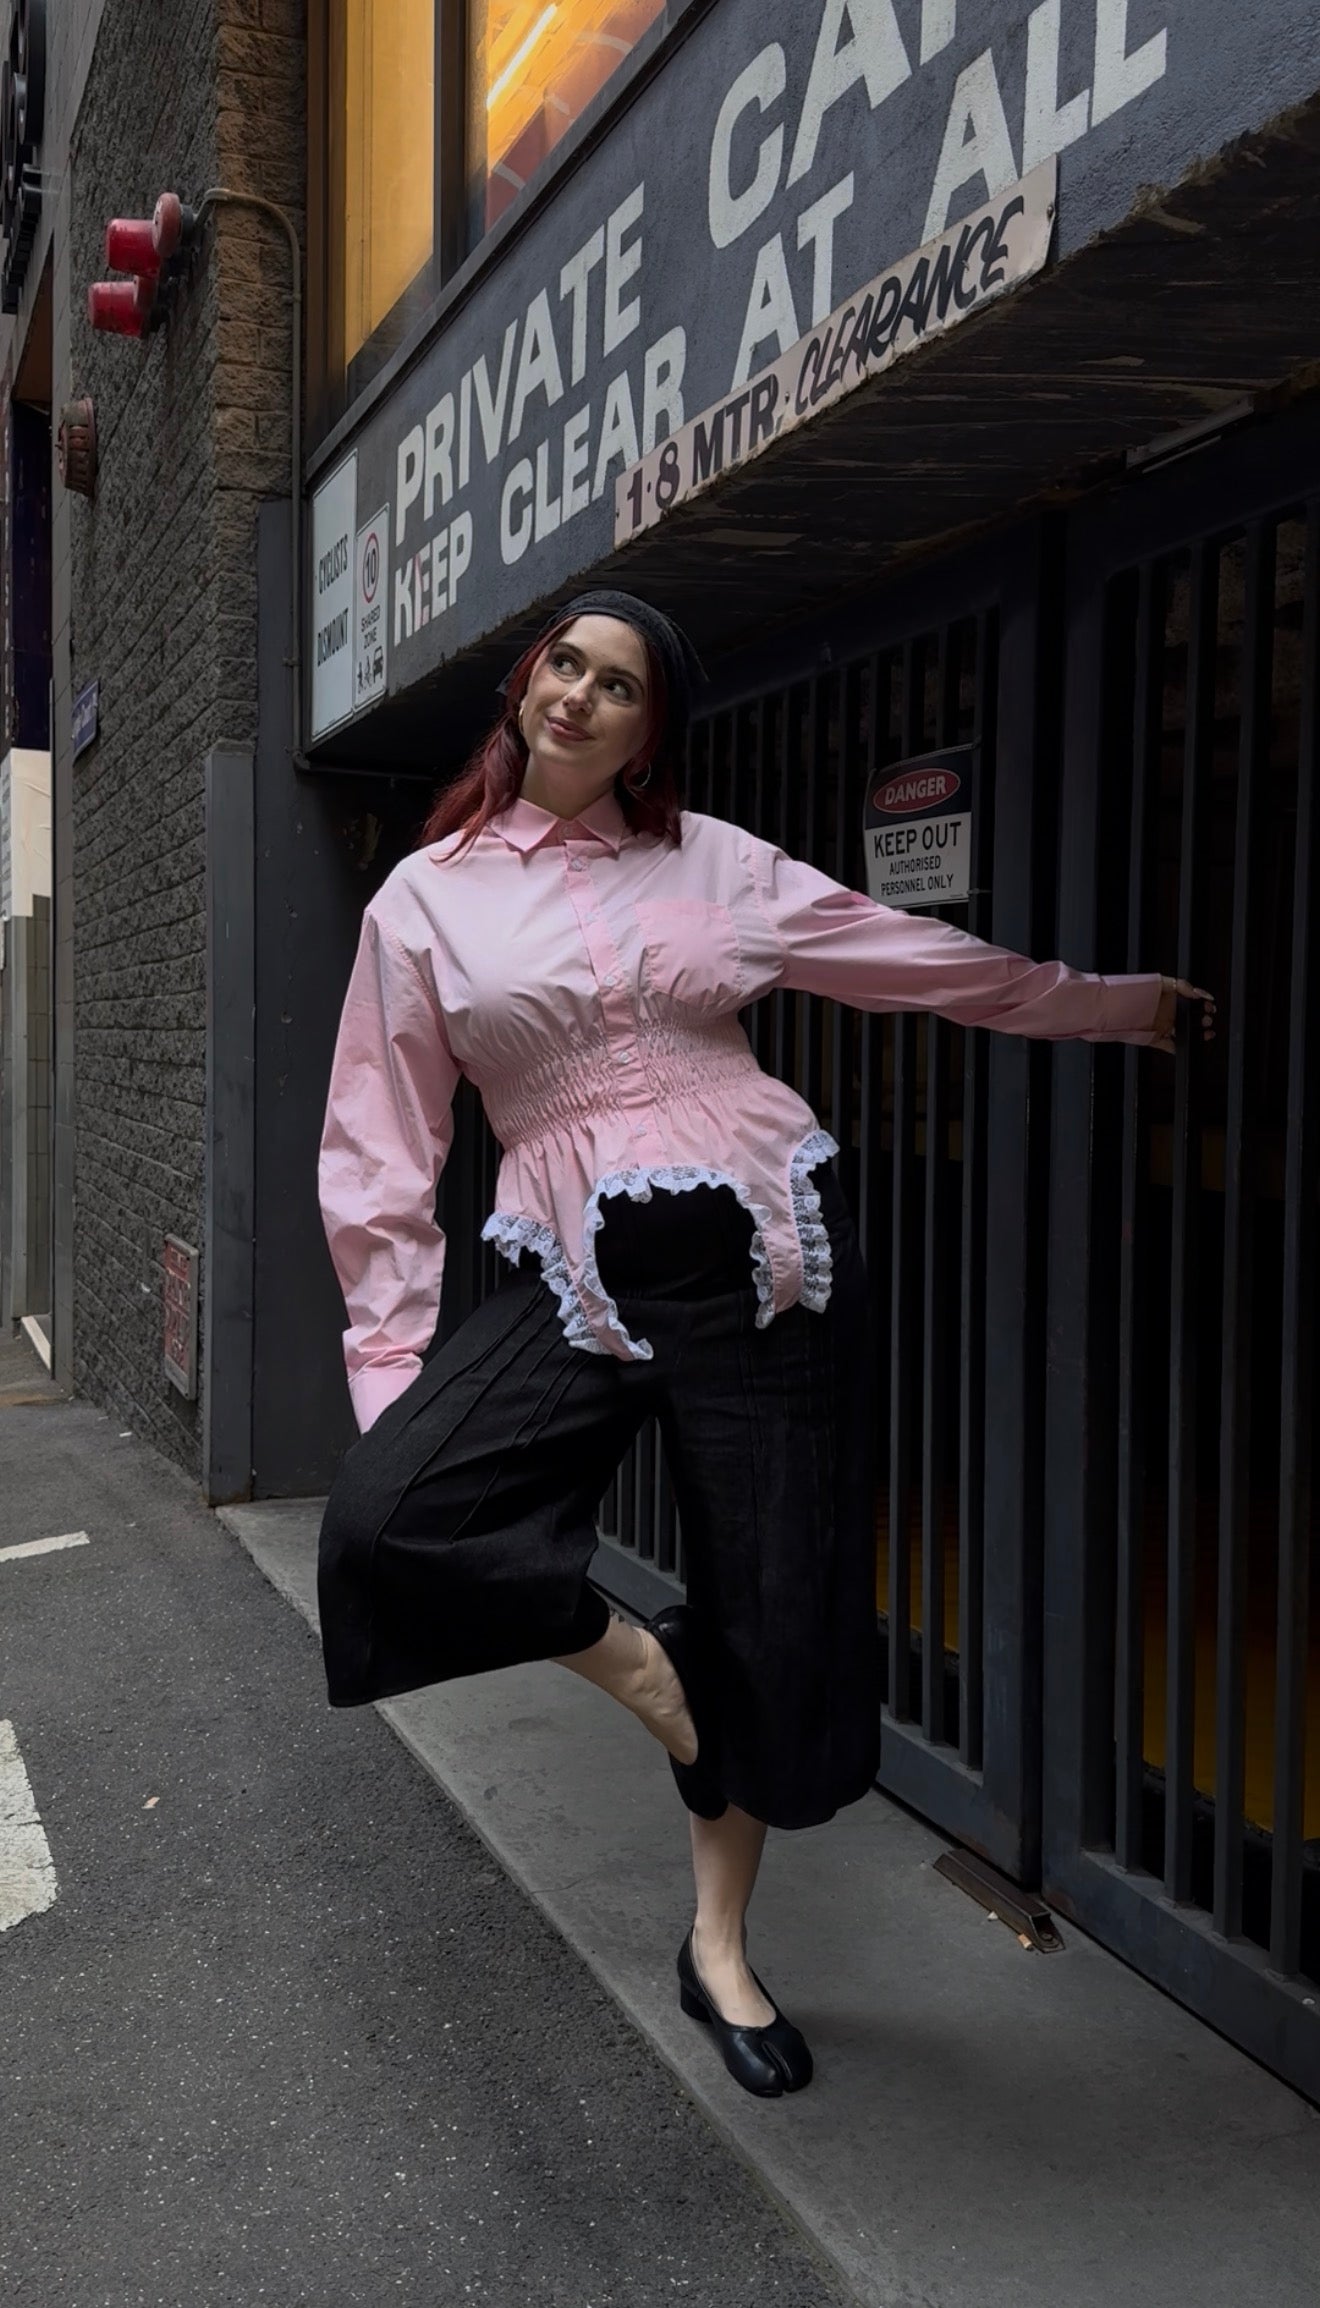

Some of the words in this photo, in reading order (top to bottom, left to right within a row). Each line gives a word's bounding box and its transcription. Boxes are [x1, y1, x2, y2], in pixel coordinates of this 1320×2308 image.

[394, 181, 646, 546] PRIVATE
[708, 0, 956, 249] CA
[394, 510, 473, 647] KEEP
[501, 325, 687, 566] CLEAR
[730, 171, 854, 393] AT
[920, 0, 1168, 248] ALL
[795, 195, 1025, 417] CLEARANCE
[319, 533, 349, 595] CYCLISTS
[365, 548, 377, 589] 10
[317, 607, 349, 667] DISMOUNT
[361, 604, 381, 633] SHARED
[363, 626, 378, 650] ZONE
[884, 775, 947, 806] DANGER
[874, 829, 917, 859] KEEP
[922, 821, 962, 851] OUT
[881, 877, 926, 896] PERSONNEL
[928, 873, 954, 889] ONLY
[889, 855, 941, 876] AUTHORISED
